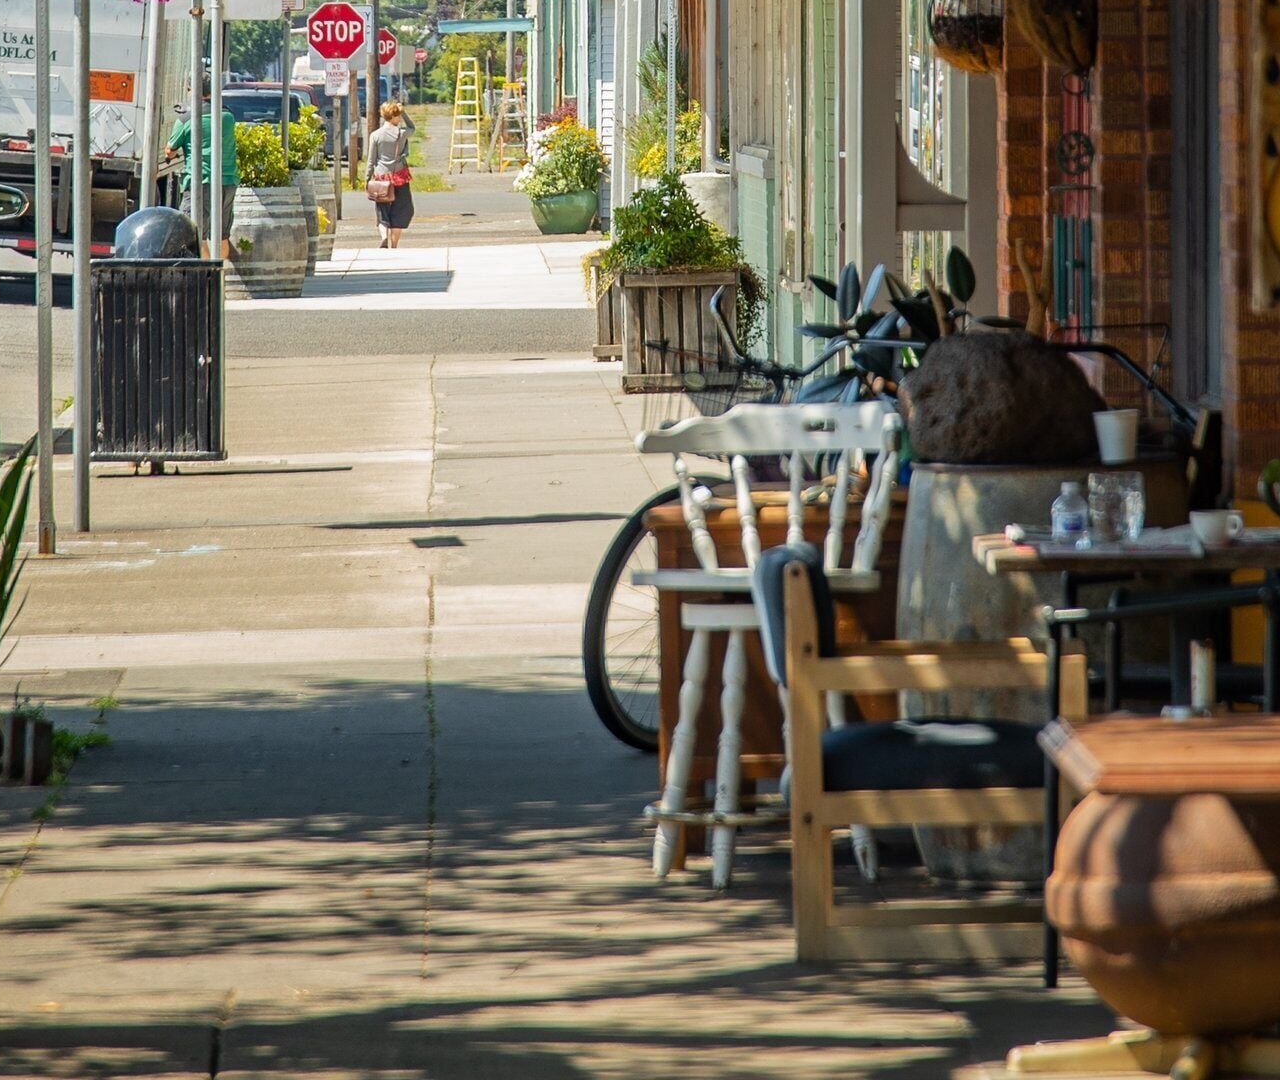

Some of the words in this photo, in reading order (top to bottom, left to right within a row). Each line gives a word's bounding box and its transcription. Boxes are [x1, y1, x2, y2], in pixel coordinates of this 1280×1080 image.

[3, 32, 18, 44] Us
[21, 34, 34, 45] At
[311, 20, 362, 42] STOP
